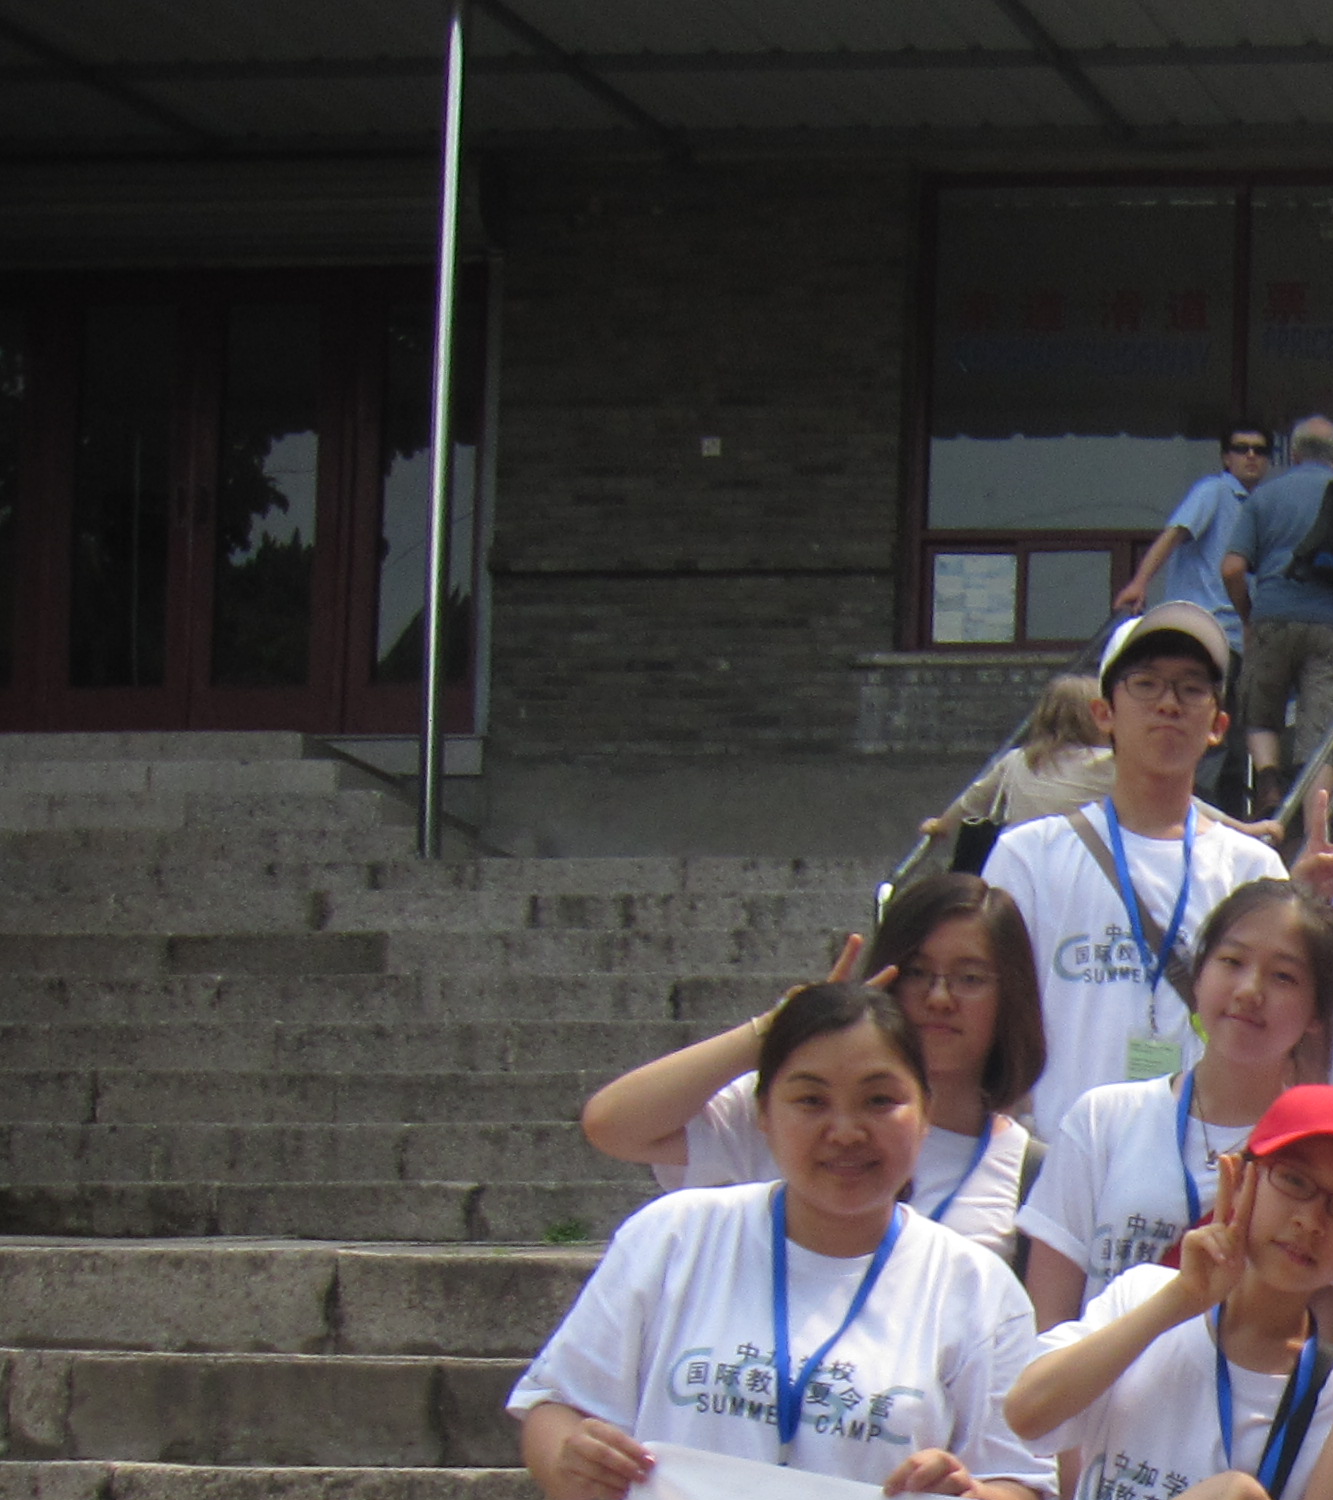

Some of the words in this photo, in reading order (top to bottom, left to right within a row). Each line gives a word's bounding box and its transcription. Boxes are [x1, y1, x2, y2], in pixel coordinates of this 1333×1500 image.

[686, 1361, 895, 1420] 国际教夏令营
[696, 1392, 778, 1426] SUMME
